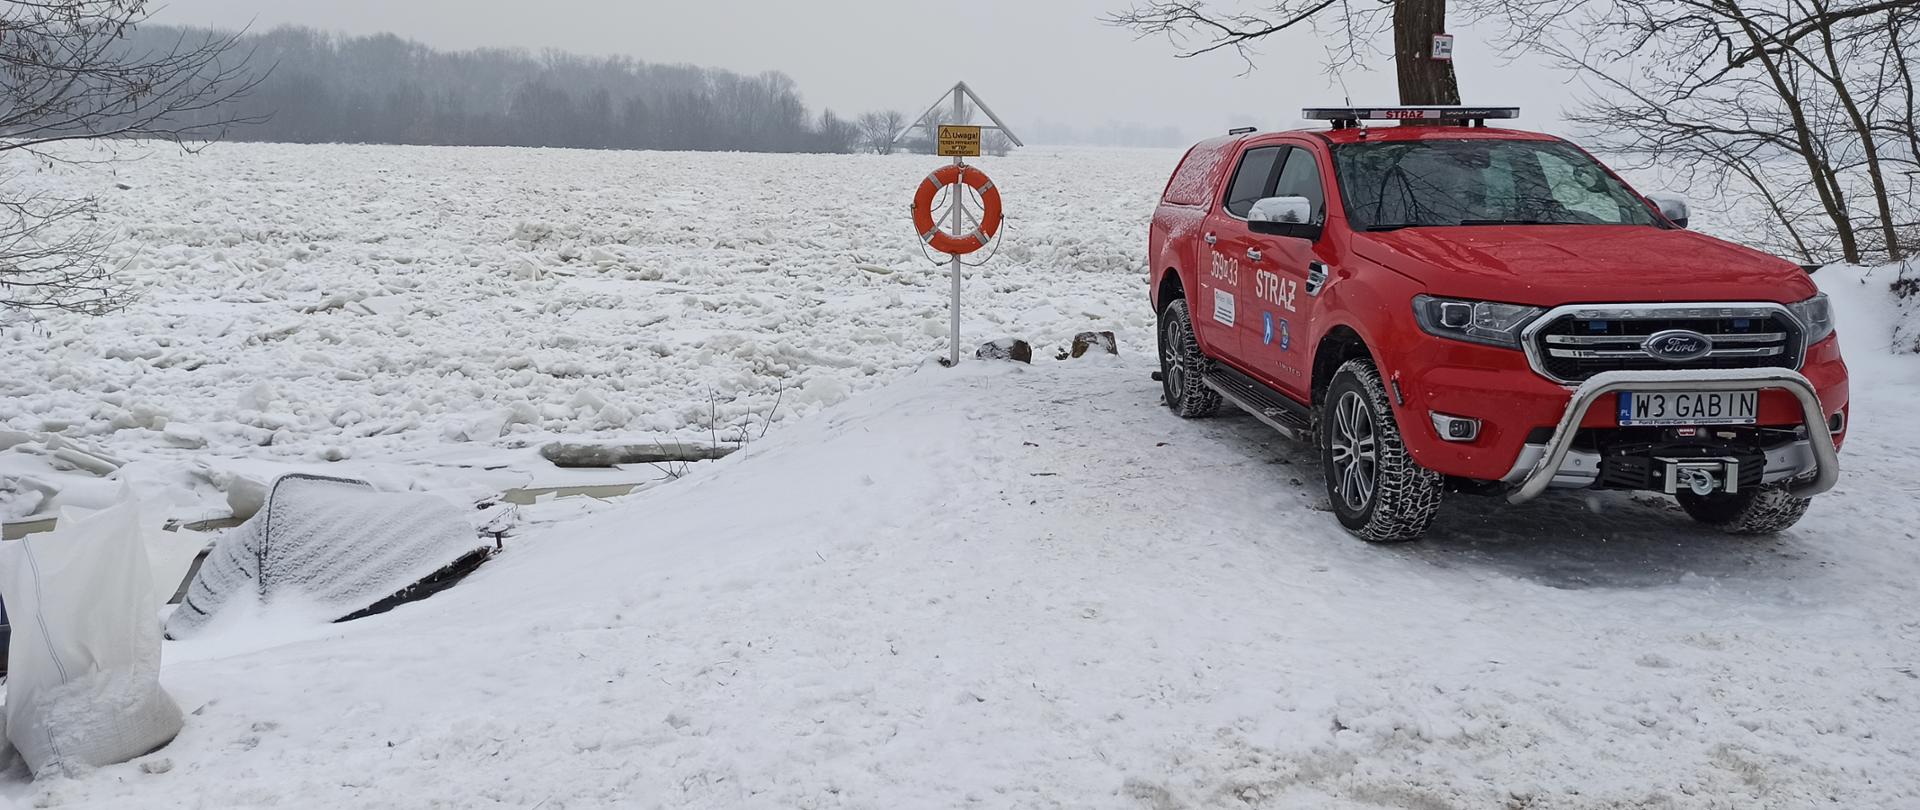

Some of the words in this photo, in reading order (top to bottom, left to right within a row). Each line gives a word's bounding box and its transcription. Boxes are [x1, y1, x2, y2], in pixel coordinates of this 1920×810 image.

[952, 132, 978, 140] Uwaga!
[1664, 337, 1698, 352] Ford
[1636, 394, 1665, 418] W3
[1676, 393, 1754, 418] GABIN
[1620, 409, 1630, 417] PL
